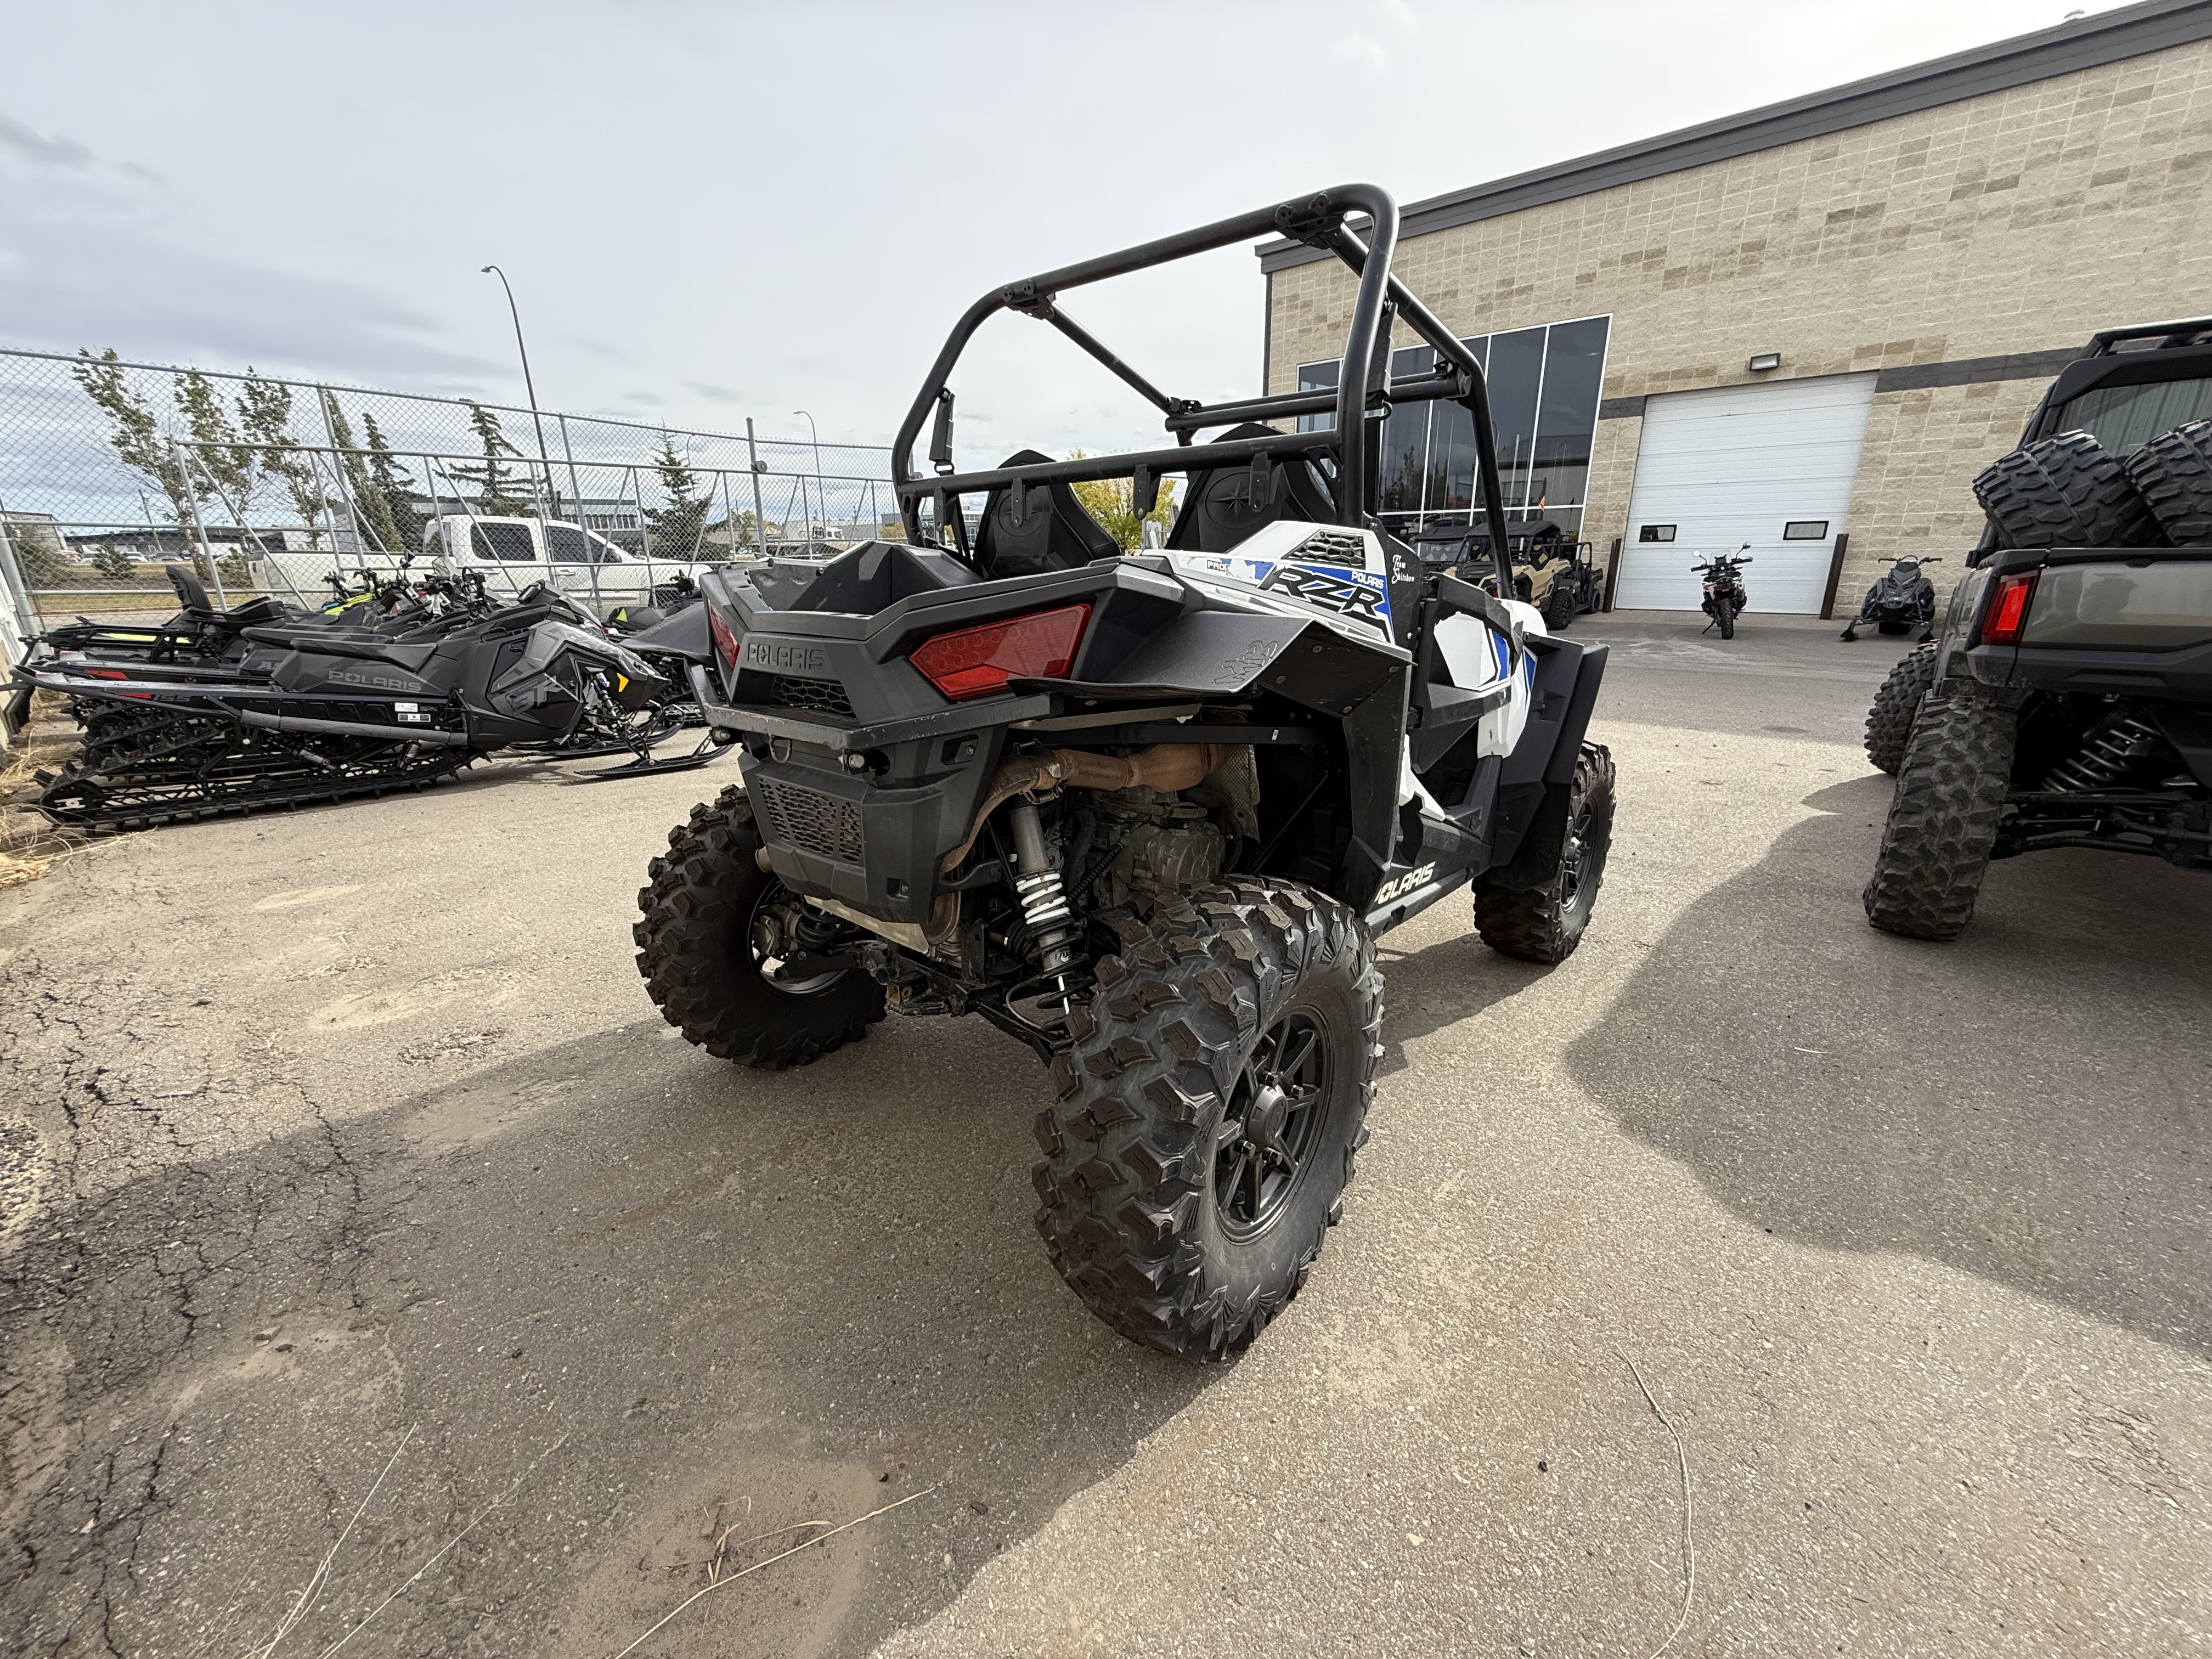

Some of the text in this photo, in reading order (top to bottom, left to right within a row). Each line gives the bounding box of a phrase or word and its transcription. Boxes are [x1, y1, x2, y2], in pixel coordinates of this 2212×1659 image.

[1393, 555, 1406, 571] Team
[1352, 571, 1384, 589] POLARIS
[1257, 565, 1385, 619] RZR
[747, 642, 825, 670] POLARIS
[329, 671, 421, 691] POLARIS
